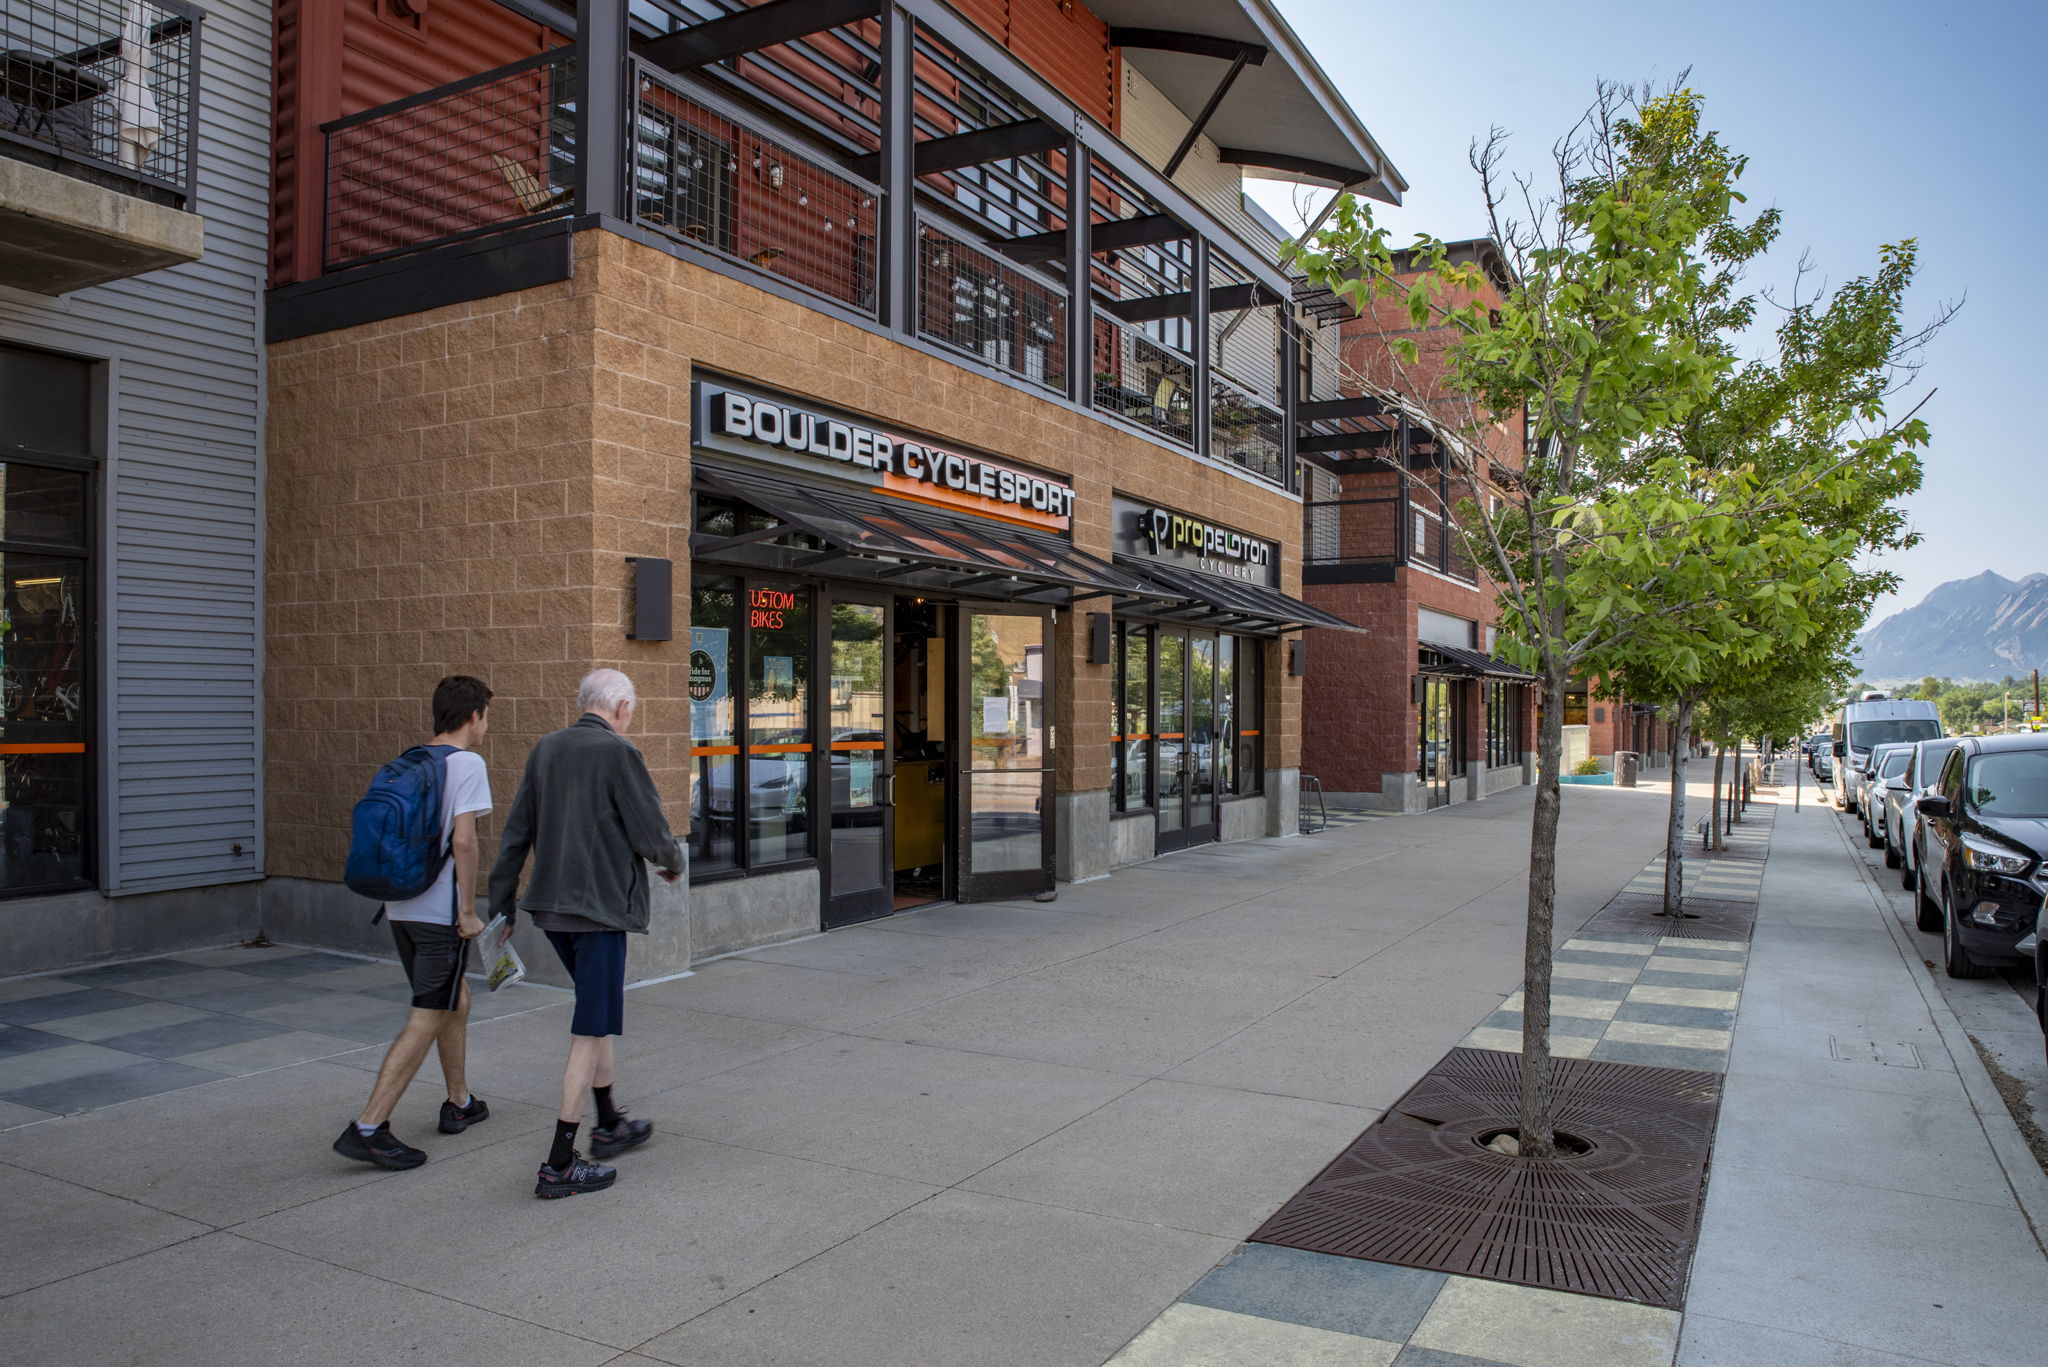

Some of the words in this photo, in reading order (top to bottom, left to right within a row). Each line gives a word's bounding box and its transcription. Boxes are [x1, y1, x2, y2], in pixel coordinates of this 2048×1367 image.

[723, 391, 893, 471] BOULDER
[1199, 557, 1255, 581] CYCLERY
[749, 589, 794, 610] USTOM
[751, 609, 784, 629] BIKES
[701, 667, 711, 676] for
